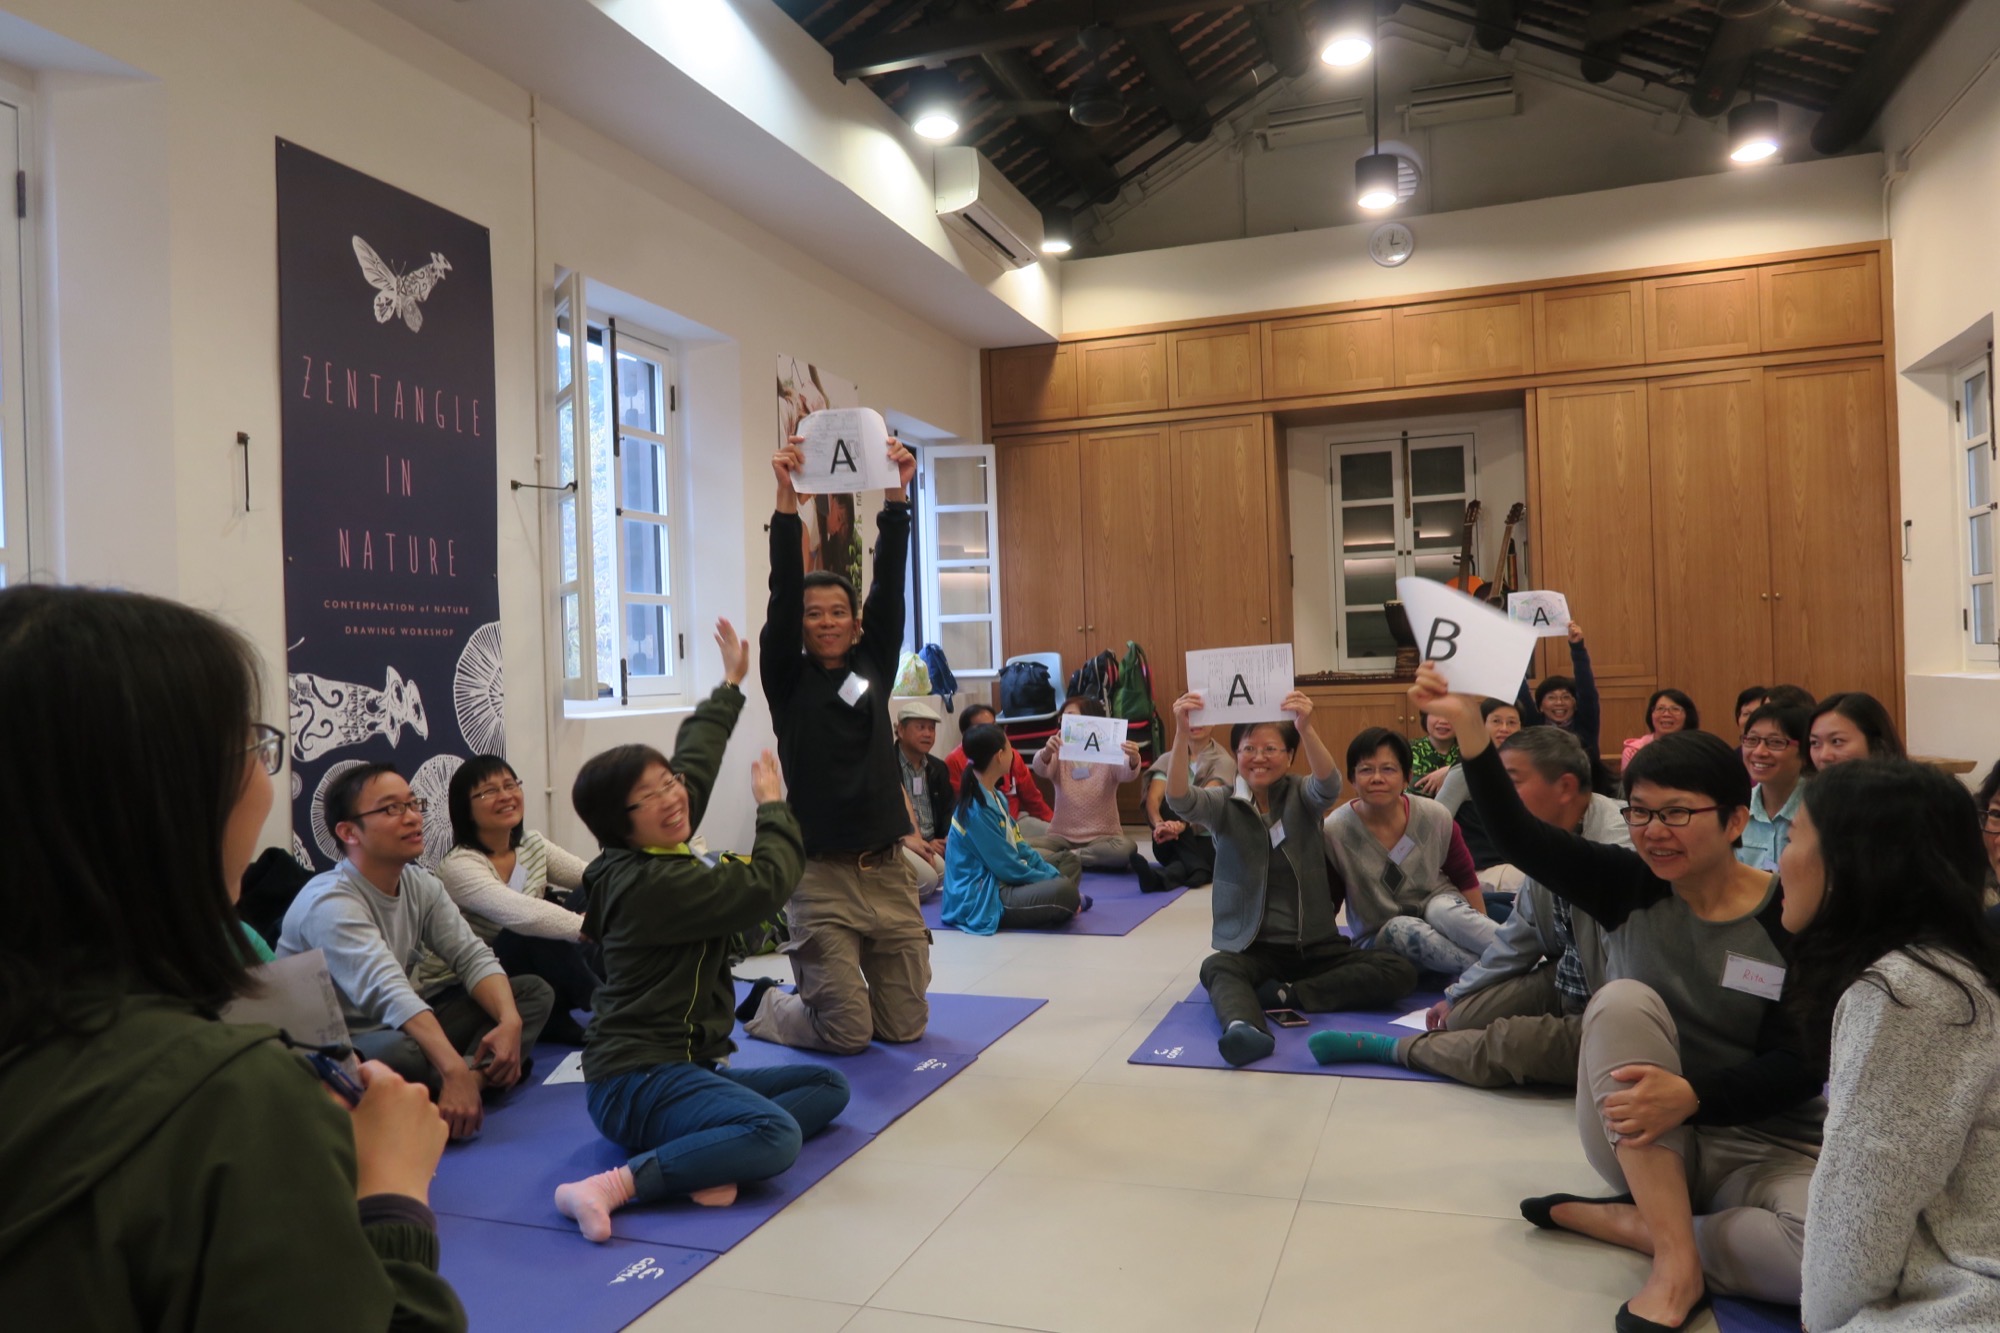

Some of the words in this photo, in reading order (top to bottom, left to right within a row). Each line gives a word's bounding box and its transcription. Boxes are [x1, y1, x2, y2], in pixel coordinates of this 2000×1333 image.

[302, 355, 481, 436] ZENTANGLE
[830, 438, 857, 475] A
[385, 455, 411, 497] IN
[339, 528, 456, 577] NATURE
[323, 600, 415, 612] CONTEMPLATION
[419, 605, 430, 613] of
[433, 605, 470, 615] NATURE
[1533, 607, 1549, 626] A
[344, 626, 396, 635] DRAWING
[400, 627, 455, 637] WORKSHOP
[1425, 617, 1461, 661] B
[1227, 673, 1254, 706] A
[1083, 732, 1100, 752] A
